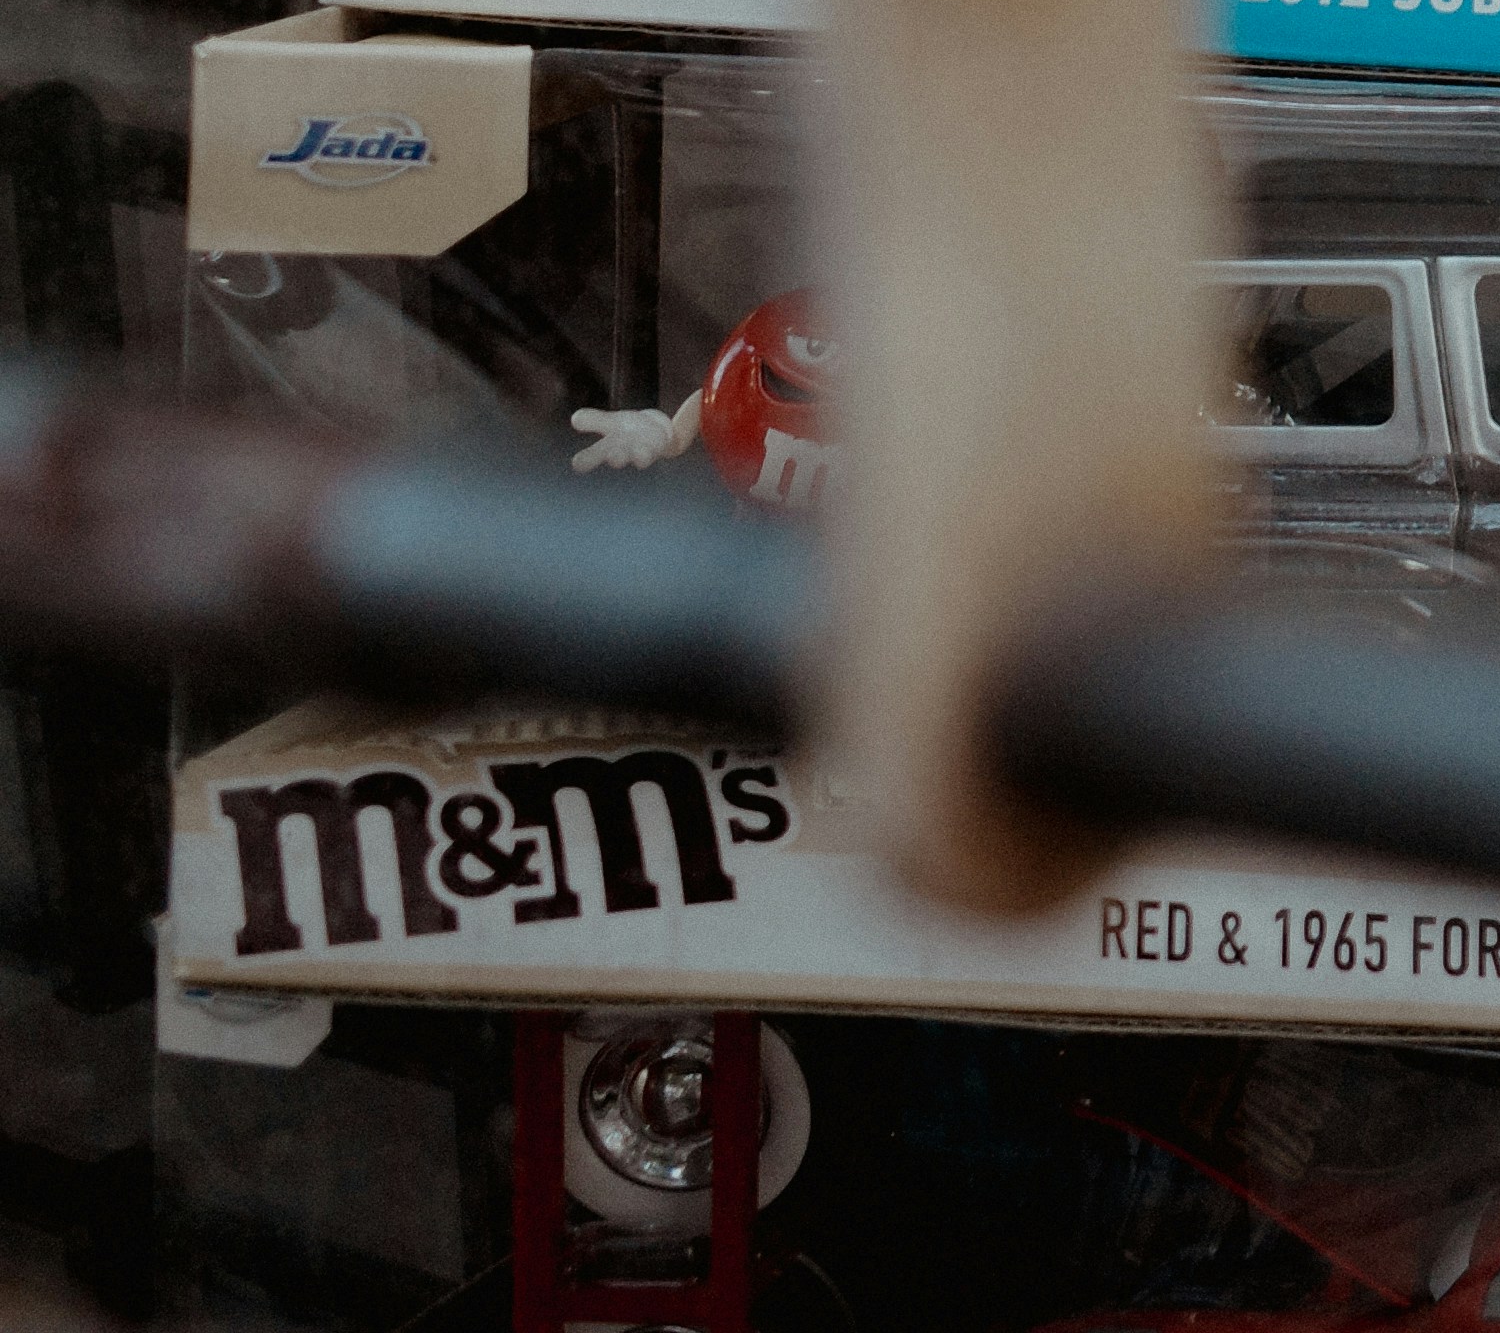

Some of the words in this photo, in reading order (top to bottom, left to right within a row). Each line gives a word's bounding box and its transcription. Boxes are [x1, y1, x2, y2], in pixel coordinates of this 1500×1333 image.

[262, 119, 432, 167] Jada
[1100, 897, 1194, 962] RED
[1217, 910, 1249, 967] &
[1274, 909, 1388, 972] 1965
